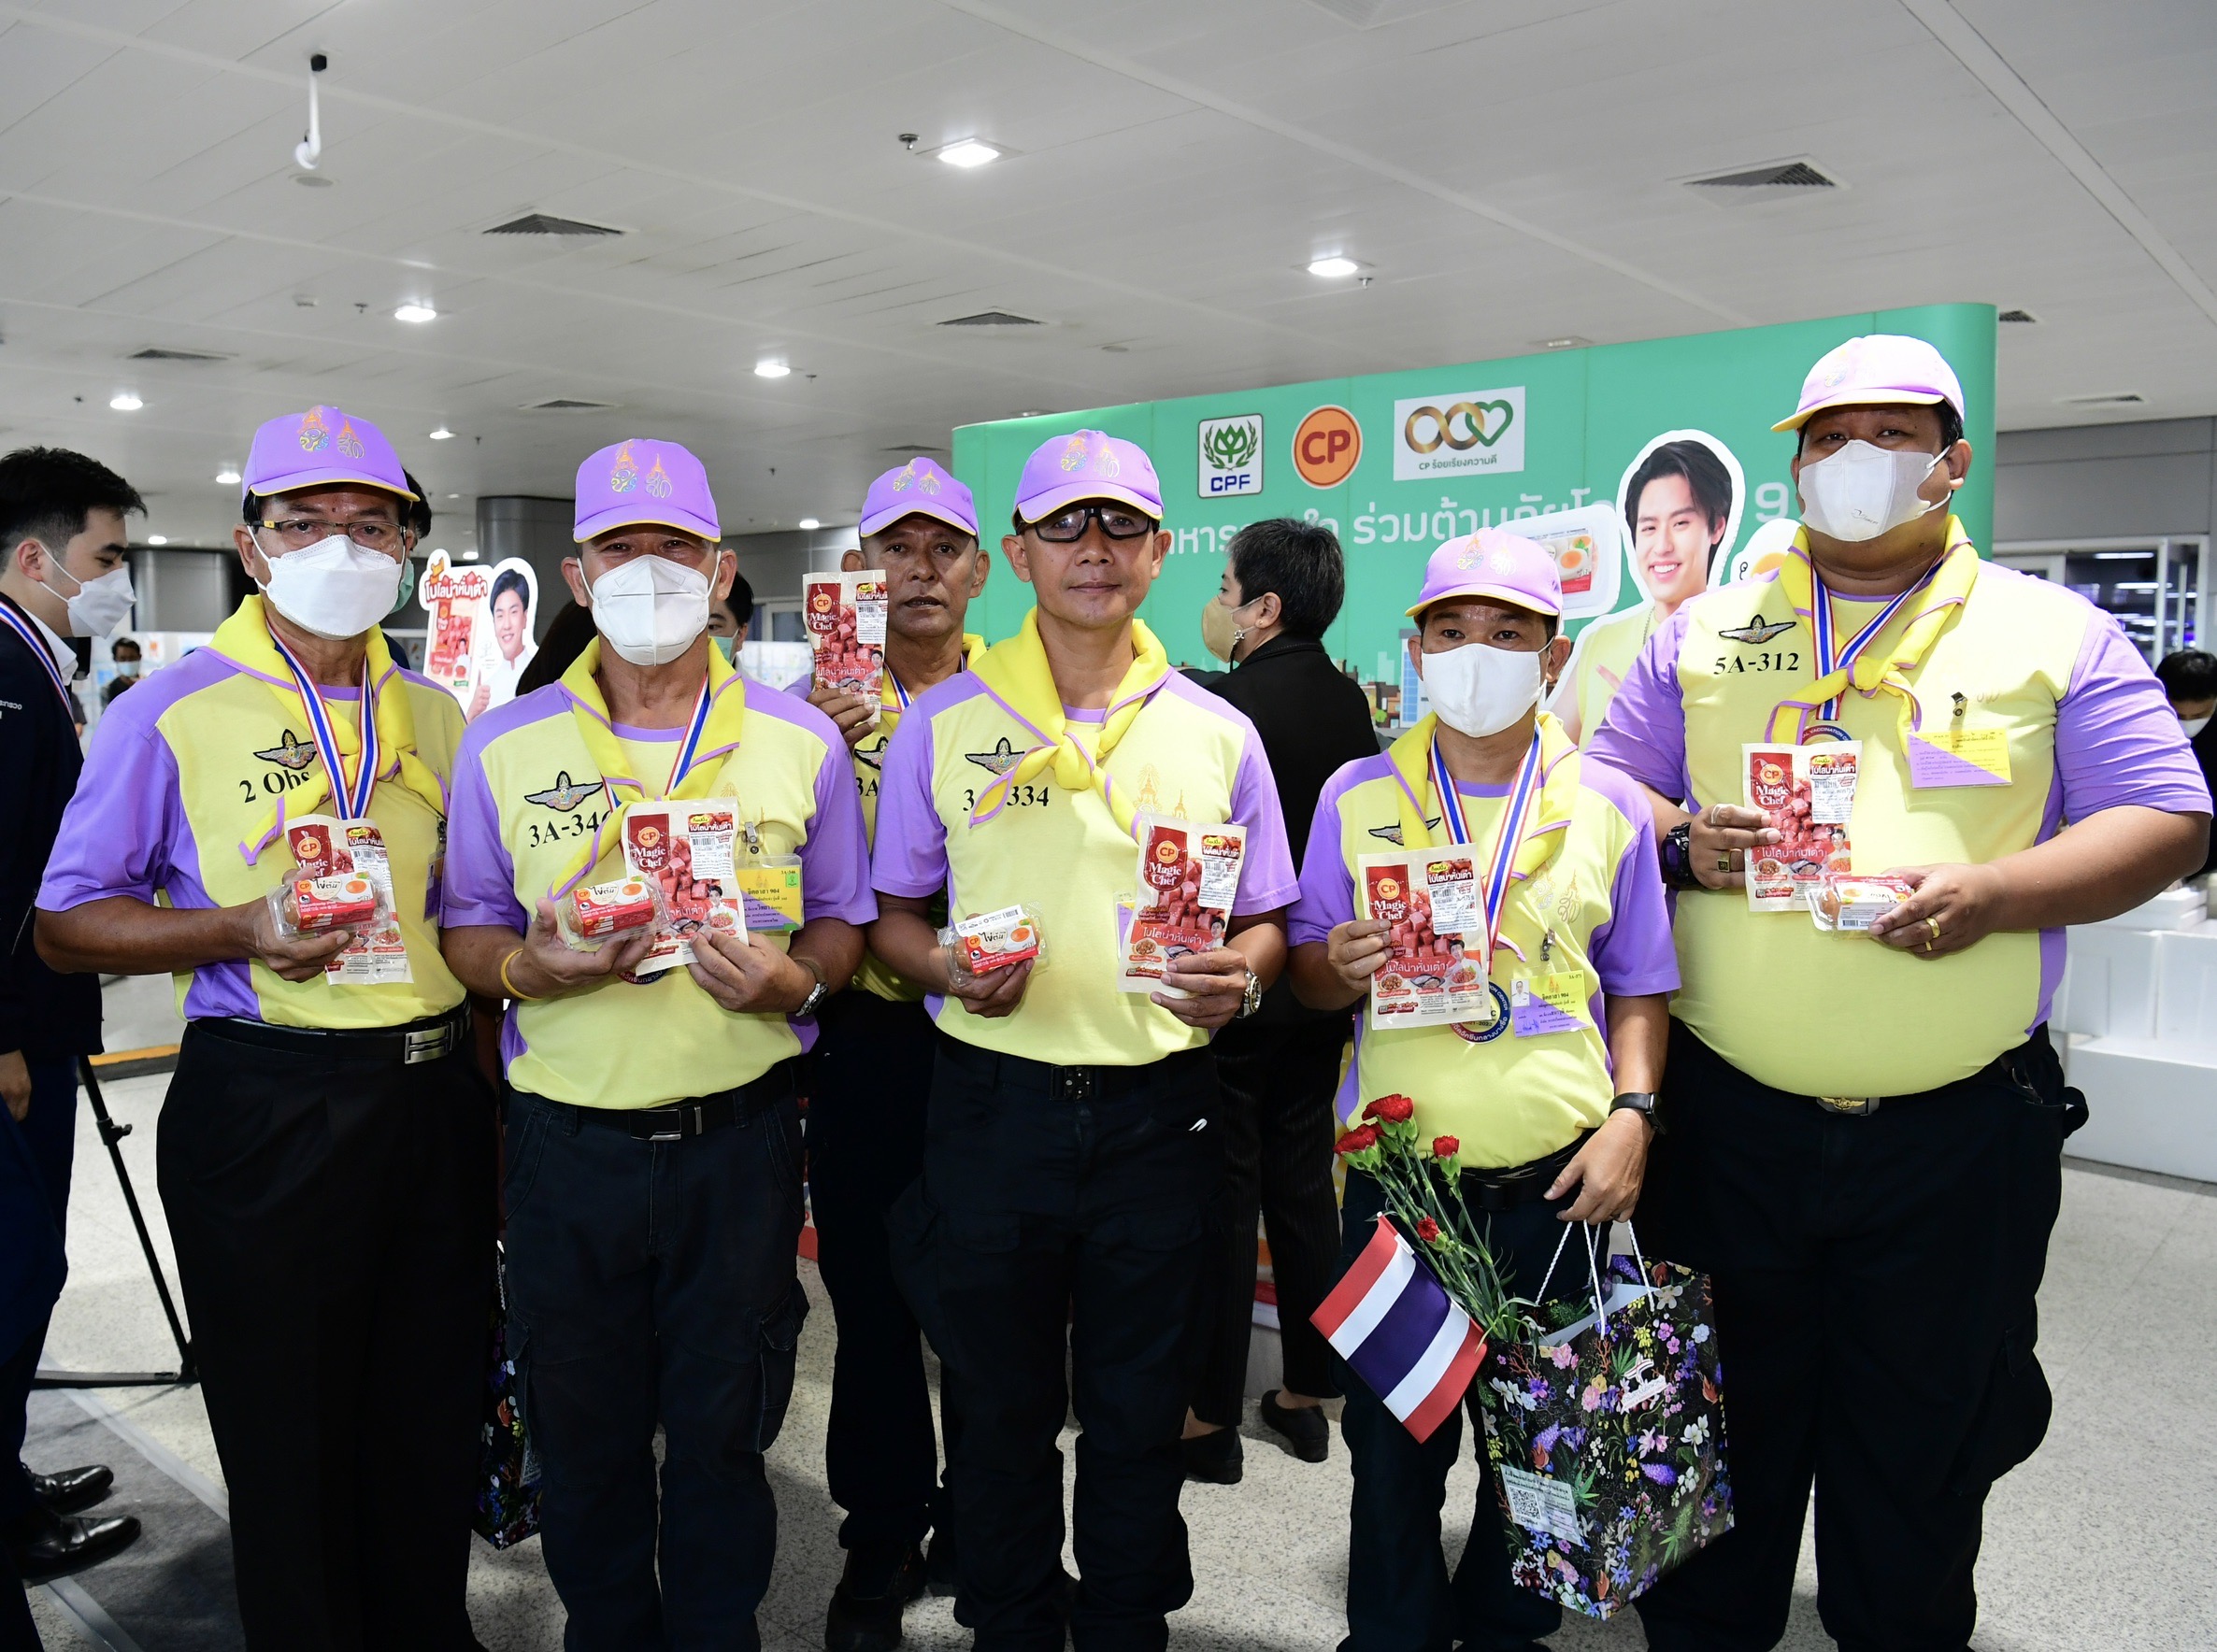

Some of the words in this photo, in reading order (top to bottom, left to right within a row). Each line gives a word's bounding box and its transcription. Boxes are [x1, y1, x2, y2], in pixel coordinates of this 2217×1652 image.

[1301, 429, 1352, 465] CP
[1418, 462, 1430, 471] CP
[1431, 453, 1497, 470] ร้อยเรียงความดี
[1210, 474, 1251, 492] CPF
[425, 575, 488, 602] โบโลน่าหั่นเต๋า
[816, 599, 829, 607] CP
[809, 612, 837, 624] Magic
[813, 620, 834, 631] Chef
[1713, 652, 1800, 676] 5A-312
[1764, 770, 1780, 779] CP
[239, 779, 257, 804] 2
[1755, 784, 1789, 797] Magic
[1760, 794, 1785, 805] Chef
[528, 809, 611, 848] 3A-34
[641, 831, 657, 841] CP
[301, 842, 318, 852] CP
[636, 846, 666, 859] Magic
[1159, 847, 1175, 857] CP
[639, 856, 664, 869] Chef
[1149, 862, 1182, 877] Magic
[1151, 874, 1178, 886] Chef
[1428, 869, 1472, 884] โบโลน่าหั่นเต๋า
[1380, 884, 1396, 893] CP
[1373, 900, 1408, 912] Magic
[1377, 910, 1404, 920] Chef
[1143, 926, 1203, 945] โบโลน่าหั่นเต๋า
[1385, 959, 1446, 974] โบโลน่าหั่นเต๋า
[1496, 991, 1509, 1011] CENTER
